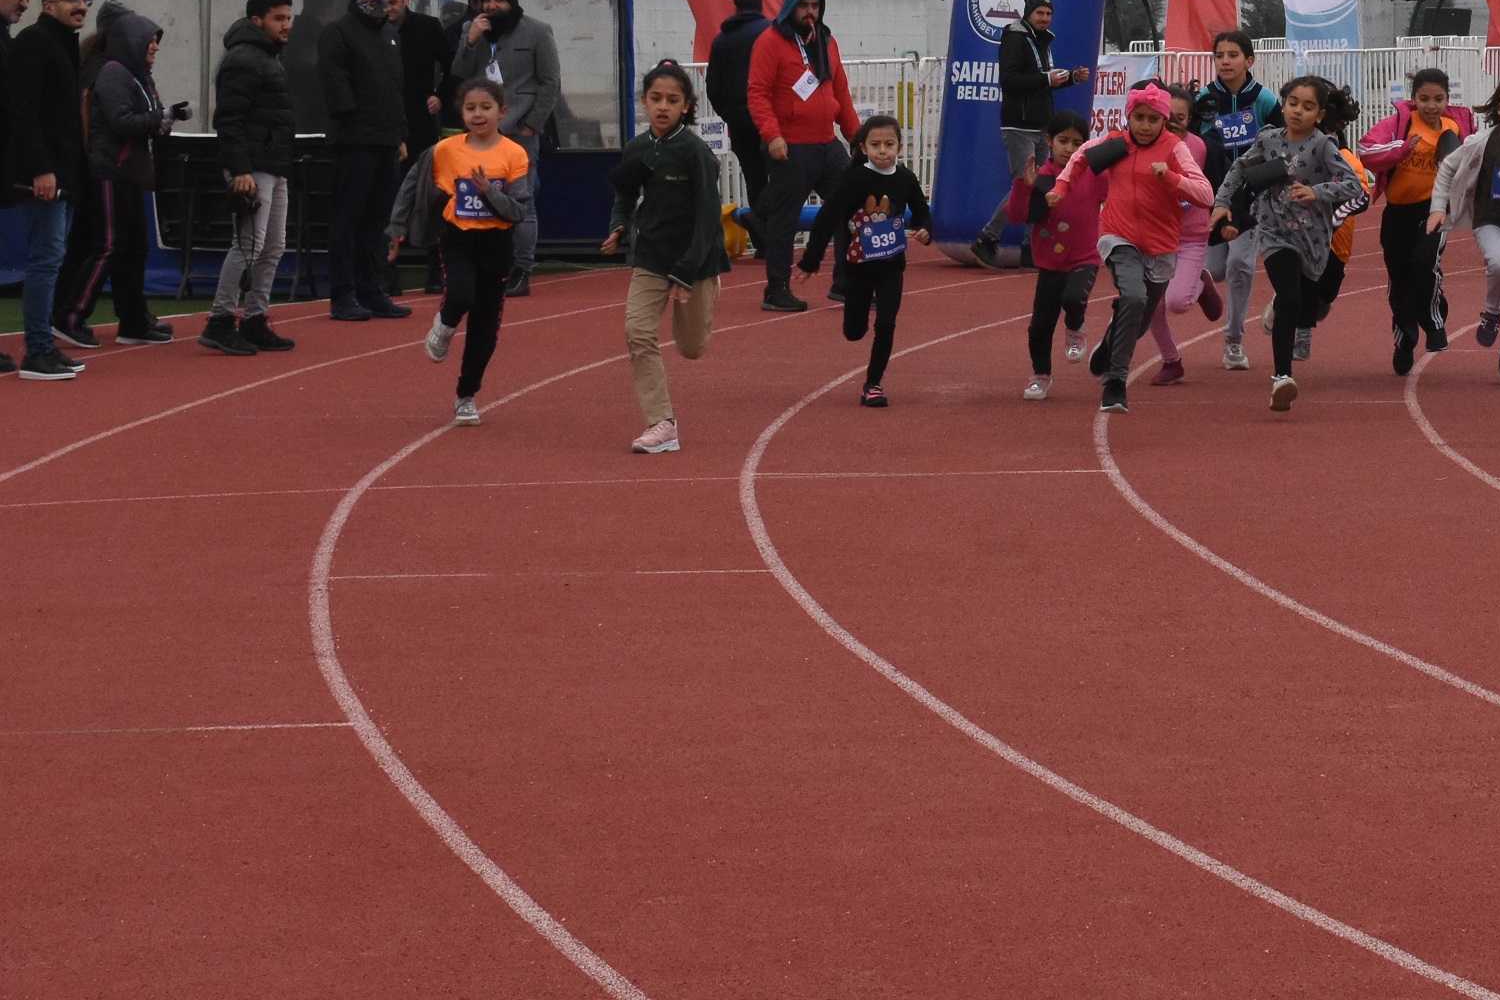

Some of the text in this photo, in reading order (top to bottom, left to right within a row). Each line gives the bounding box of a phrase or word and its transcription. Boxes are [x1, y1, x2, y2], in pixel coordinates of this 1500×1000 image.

[1222, 124, 1248, 139] 524
[464, 195, 483, 210] 26
[871, 231, 896, 249] 939
